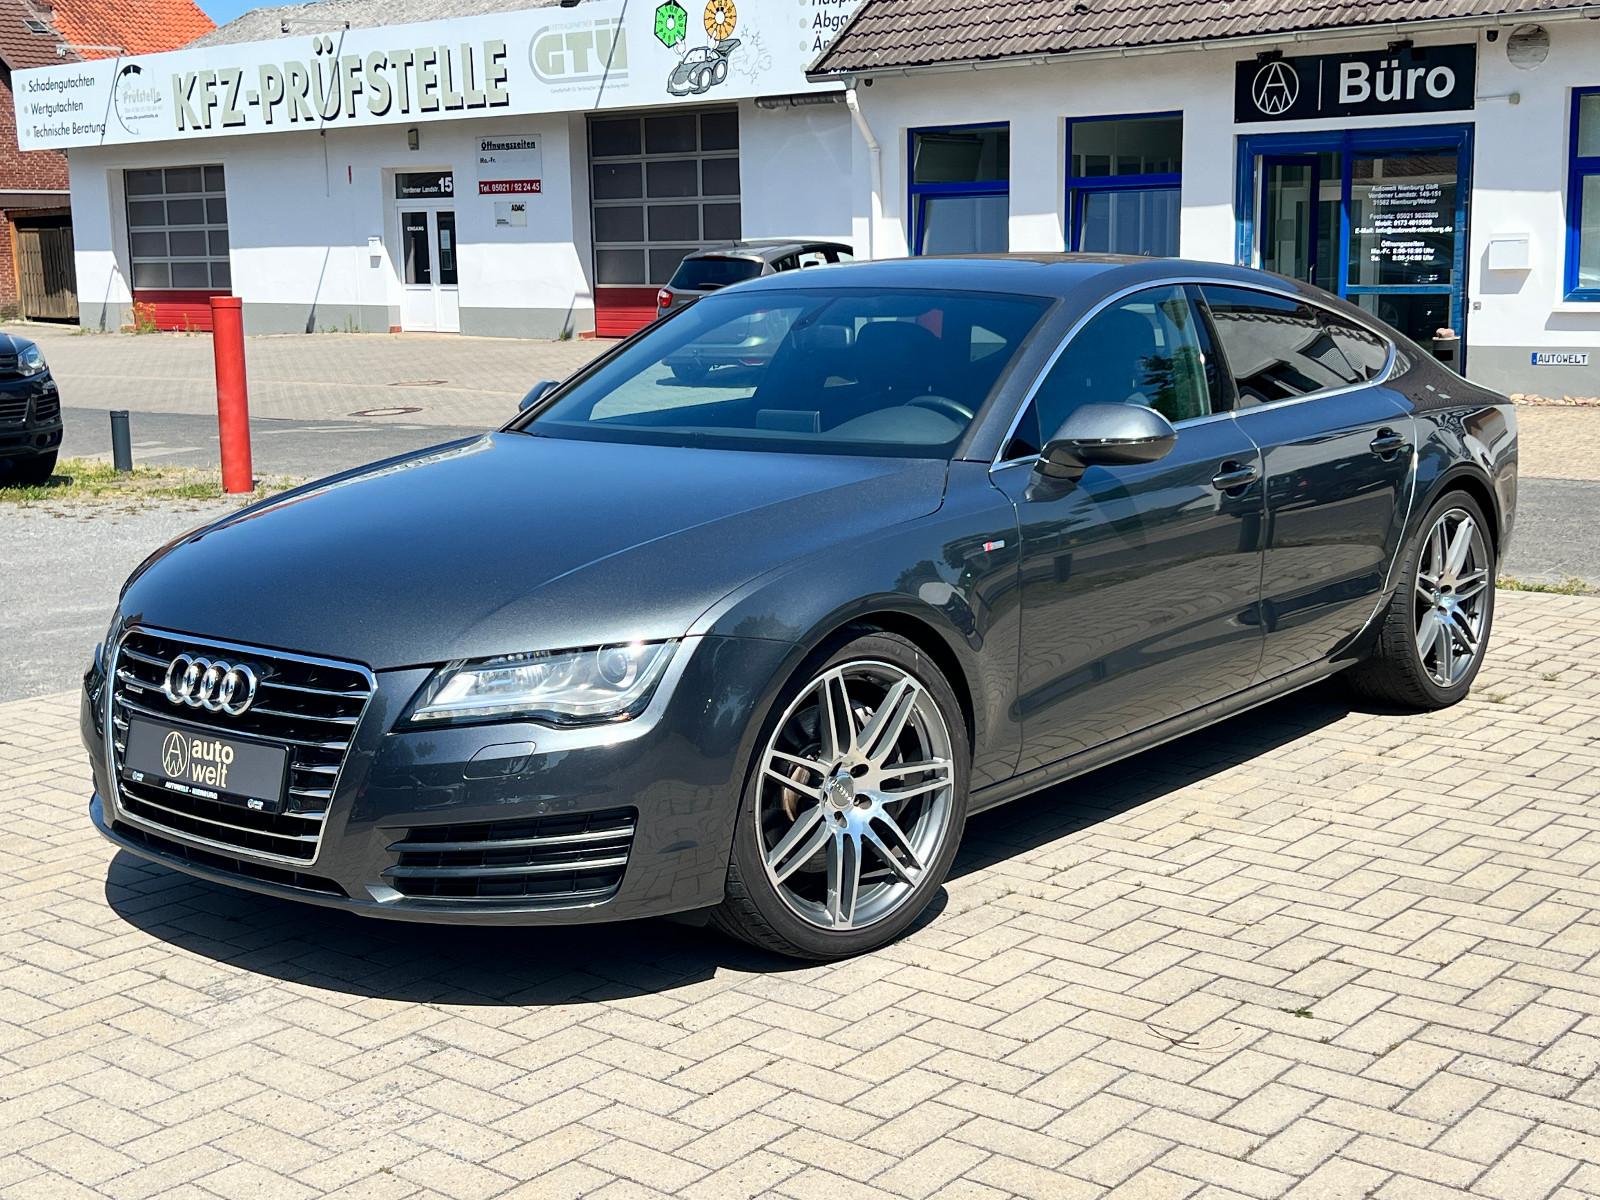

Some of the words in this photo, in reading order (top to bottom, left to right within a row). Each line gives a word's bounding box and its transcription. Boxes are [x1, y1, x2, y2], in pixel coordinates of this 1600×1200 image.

[534, 17, 628, 75] GTÜ
[28, 73, 95, 93] Schadengutachten
[172, 34, 509, 131] KFZ-PRÜFSTELLE
[1339, 59, 1456, 104] Büro
[30, 98, 84, 118] Wertgutachten
[33, 122, 70, 138] Technische
[72, 121, 106, 136] Beratung
[480, 139, 536, 151] Öffnungszeiten
[439, 177, 453, 193] 15
[480, 184, 491, 193] Tel.
[491, 183, 510, 192] 05021
[514, 182, 522, 191] 92
[523, 182, 531, 191] 24
[531, 182, 540, 191] 45
[1538, 354, 1587, 364] AUTOWELT
[191, 739, 234, 765] auto
[191, 762, 228, 788] welt
